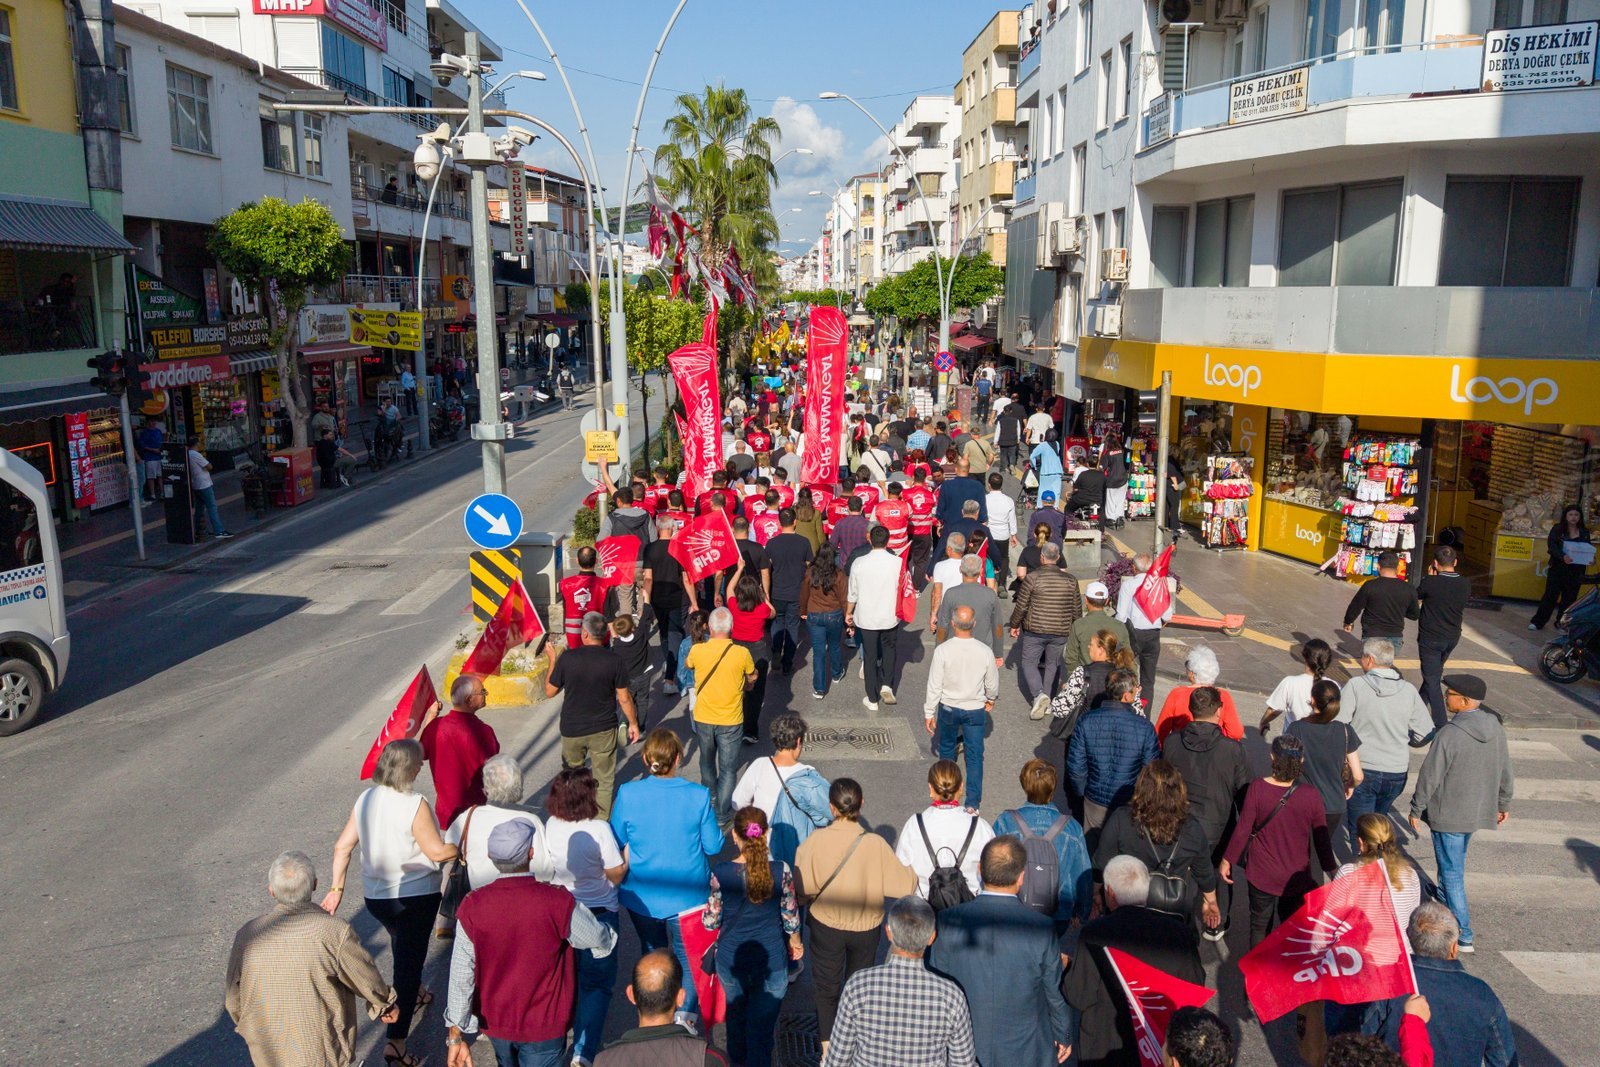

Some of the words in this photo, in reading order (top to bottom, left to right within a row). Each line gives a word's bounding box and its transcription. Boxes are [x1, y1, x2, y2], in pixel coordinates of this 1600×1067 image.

[1490, 33, 1520, 56] DİŞ
[1523, 26, 1592, 51] HEKİMİ
[1489, 57, 1520, 72] DERYA
[1523, 53, 1557, 69] DOĞRU
[1560, 50, 1590, 69] ÇELİK
[1233, 82, 1254, 97] DİŞ
[1257, 69, 1302, 93] HEKİMİ
[1494, 80, 1524, 88] 0535
[1234, 97, 1255, 111] DERYA
[1257, 92, 1281, 107] DOĞRU
[1282, 86, 1303, 103] ÇELİK
[514, 215, 525, 253] KURSU
[151, 327, 192, 346] TELEFON
[193, 327, 226, 343] BORSASI
[148, 362, 212, 389] vodafone
[0, 590, 31, 606] AVGAT
